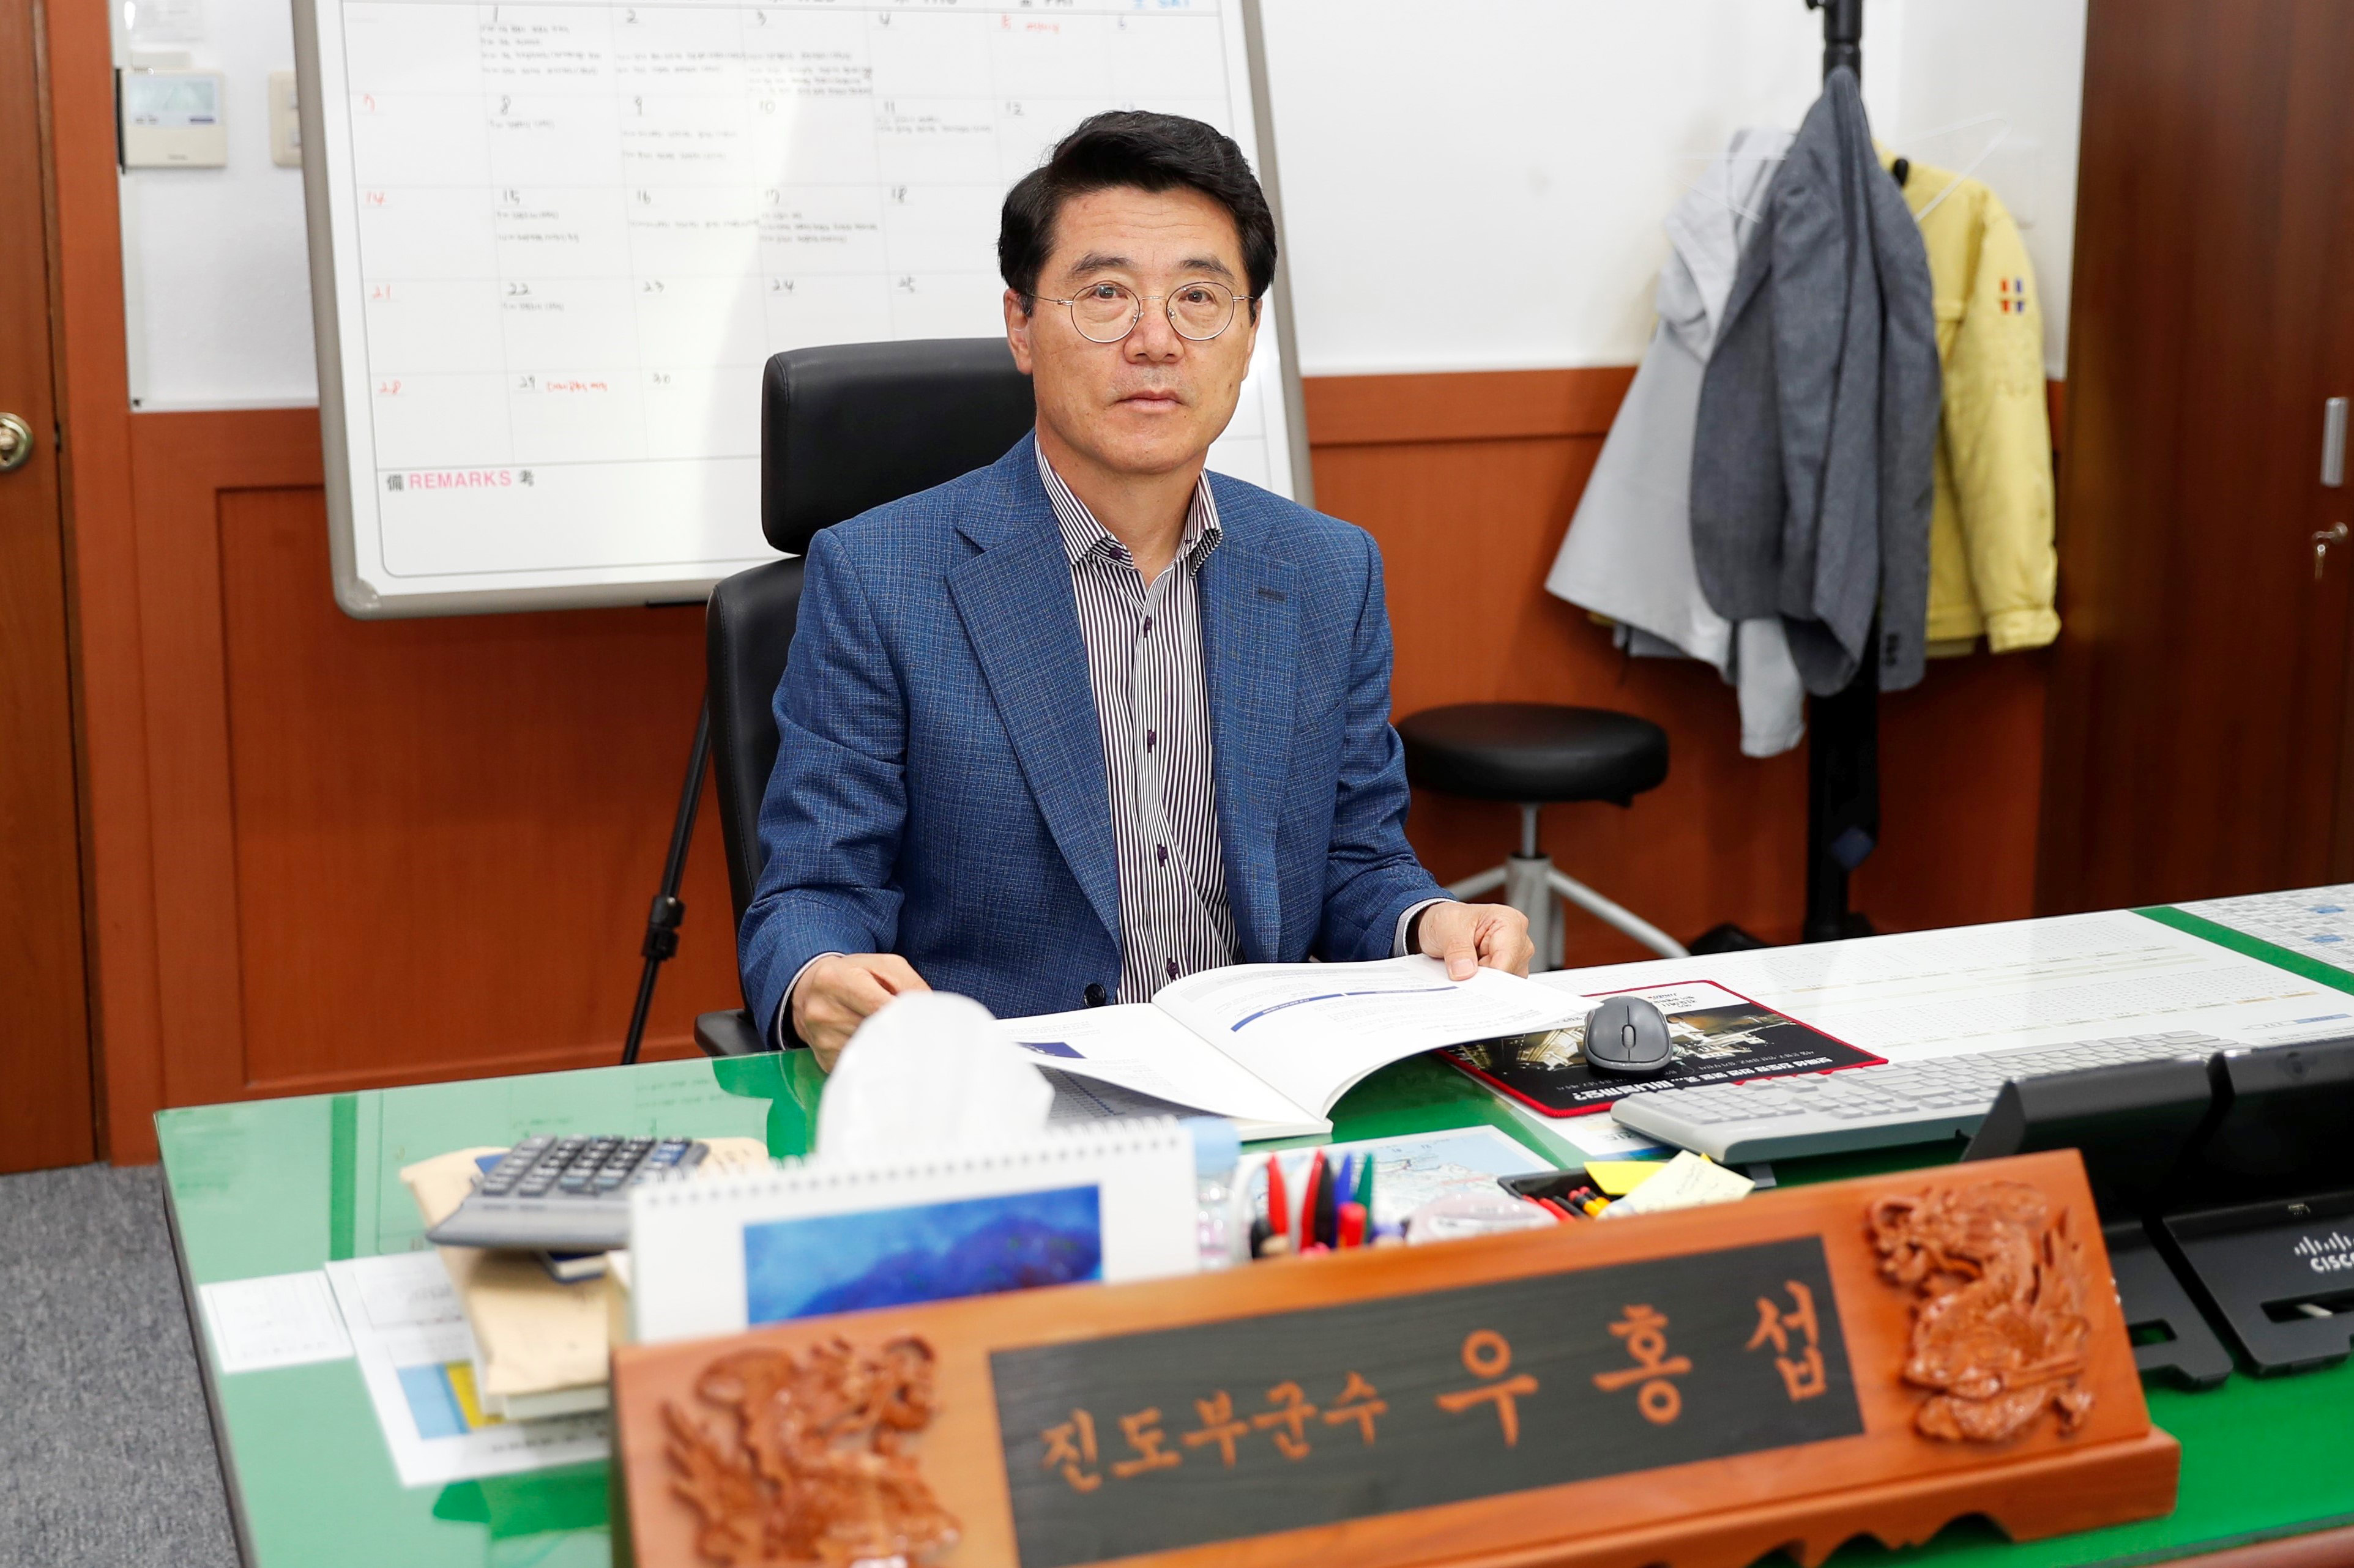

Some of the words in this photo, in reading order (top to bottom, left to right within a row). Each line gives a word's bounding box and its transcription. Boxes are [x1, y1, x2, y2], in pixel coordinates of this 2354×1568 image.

[625, 9, 639, 23] 2
[756, 9, 767, 26] 3
[879, 10, 893, 26] 4
[1117, 14, 1127, 30] 6
[500, 95, 512, 115] 8
[634, 96, 643, 116] 9
[759, 100, 776, 114] 10
[884, 101, 898, 114] 11
[1005, 102, 1024, 116] 12
[367, 192, 386, 205] 14
[504, 190, 520, 204] 15
[637, 190, 652, 205] 16
[765, 189, 781, 204] 17
[892, 187, 908, 204] 18
[507, 283, 532, 295] 22
[644, 281, 665, 293] 23
[772, 279, 795, 293] 24
[898, 275, 916, 293] 25
[372, 284, 392, 299] 21
[520, 376, 536, 390] 29
[653, 373, 671, 385] 30
[378, 381, 402, 395] 28
[409, 470, 512, 489] REMARKS
[1040, 1371, 1389, 1493] 진도부군수
